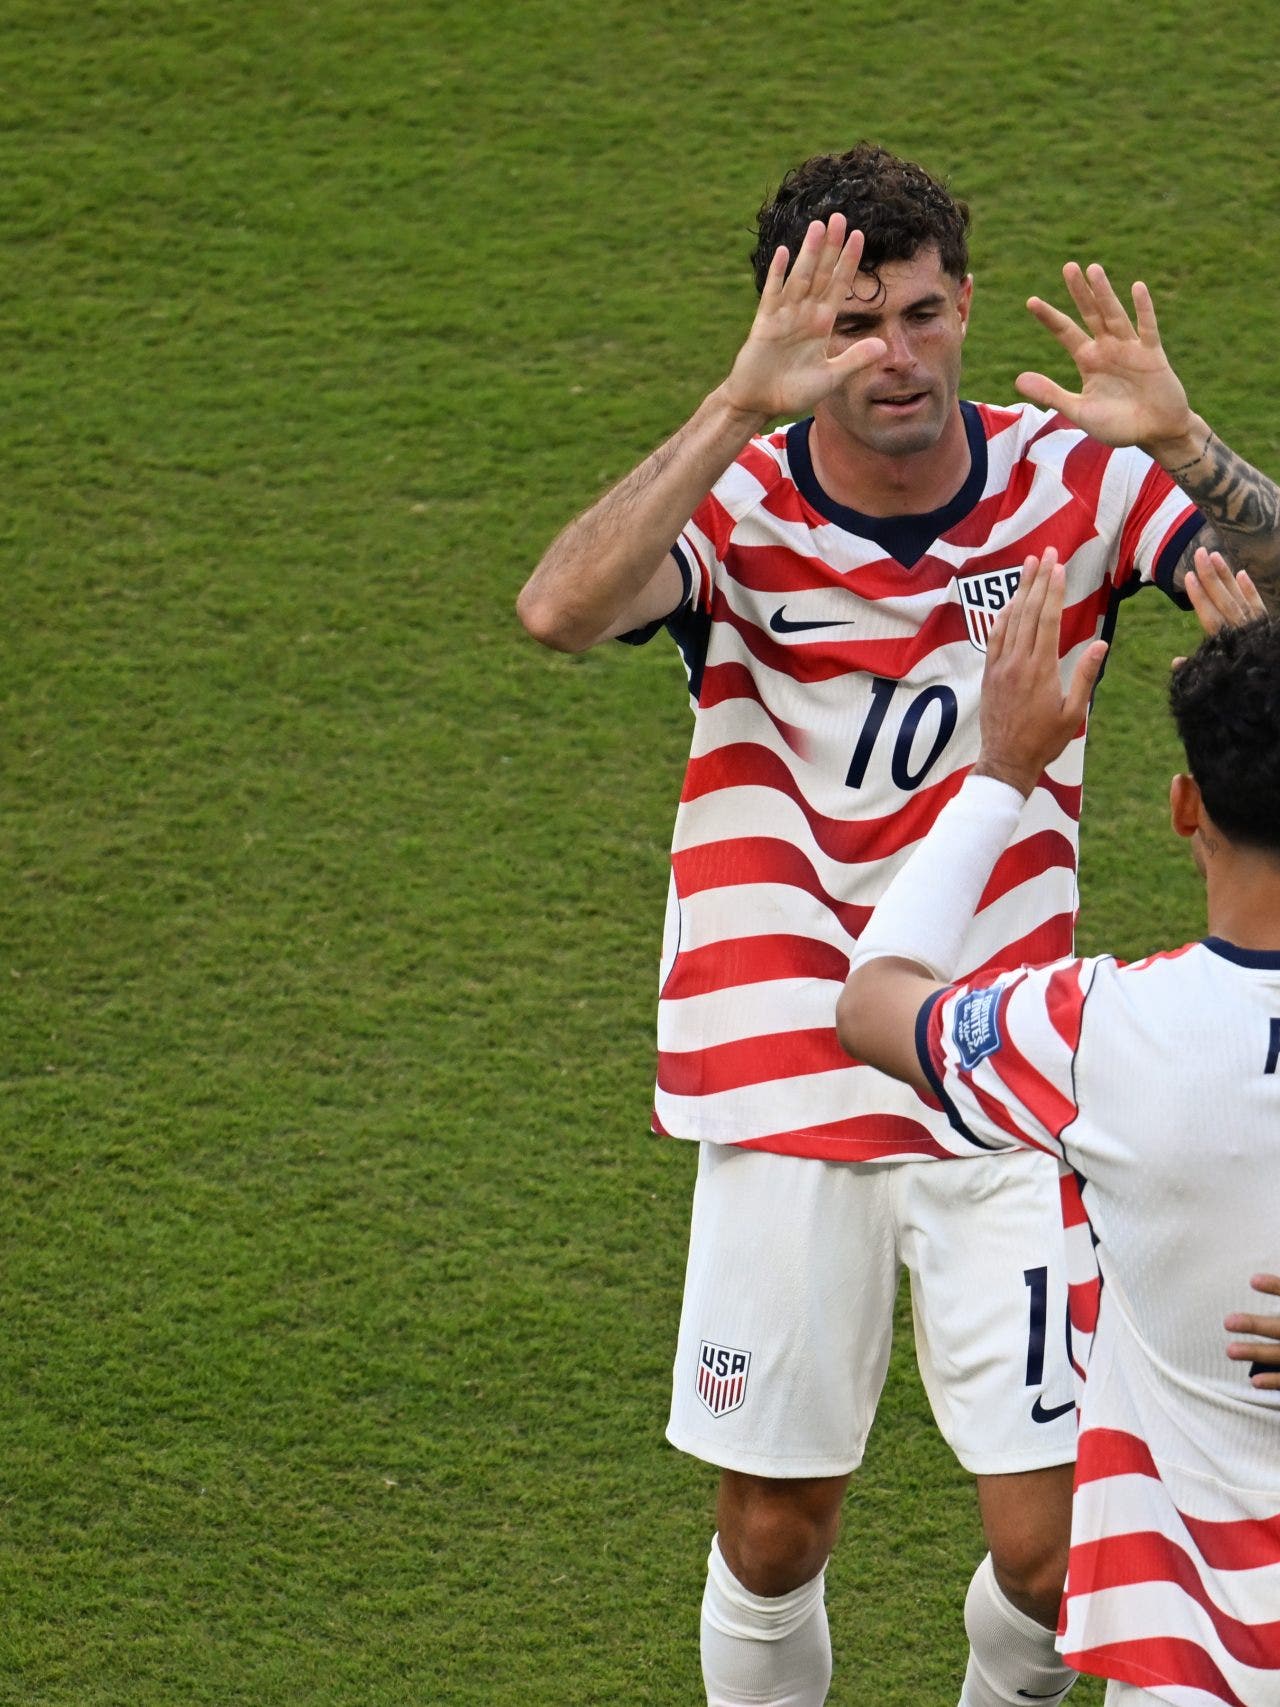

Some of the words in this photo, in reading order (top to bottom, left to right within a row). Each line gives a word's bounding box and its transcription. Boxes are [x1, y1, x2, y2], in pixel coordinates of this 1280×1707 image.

[963, 571, 1021, 611] USA
[845, 676, 958, 791] 10
[702, 1345, 746, 1377] USA
[1023, 1266, 1074, 1387] 1
